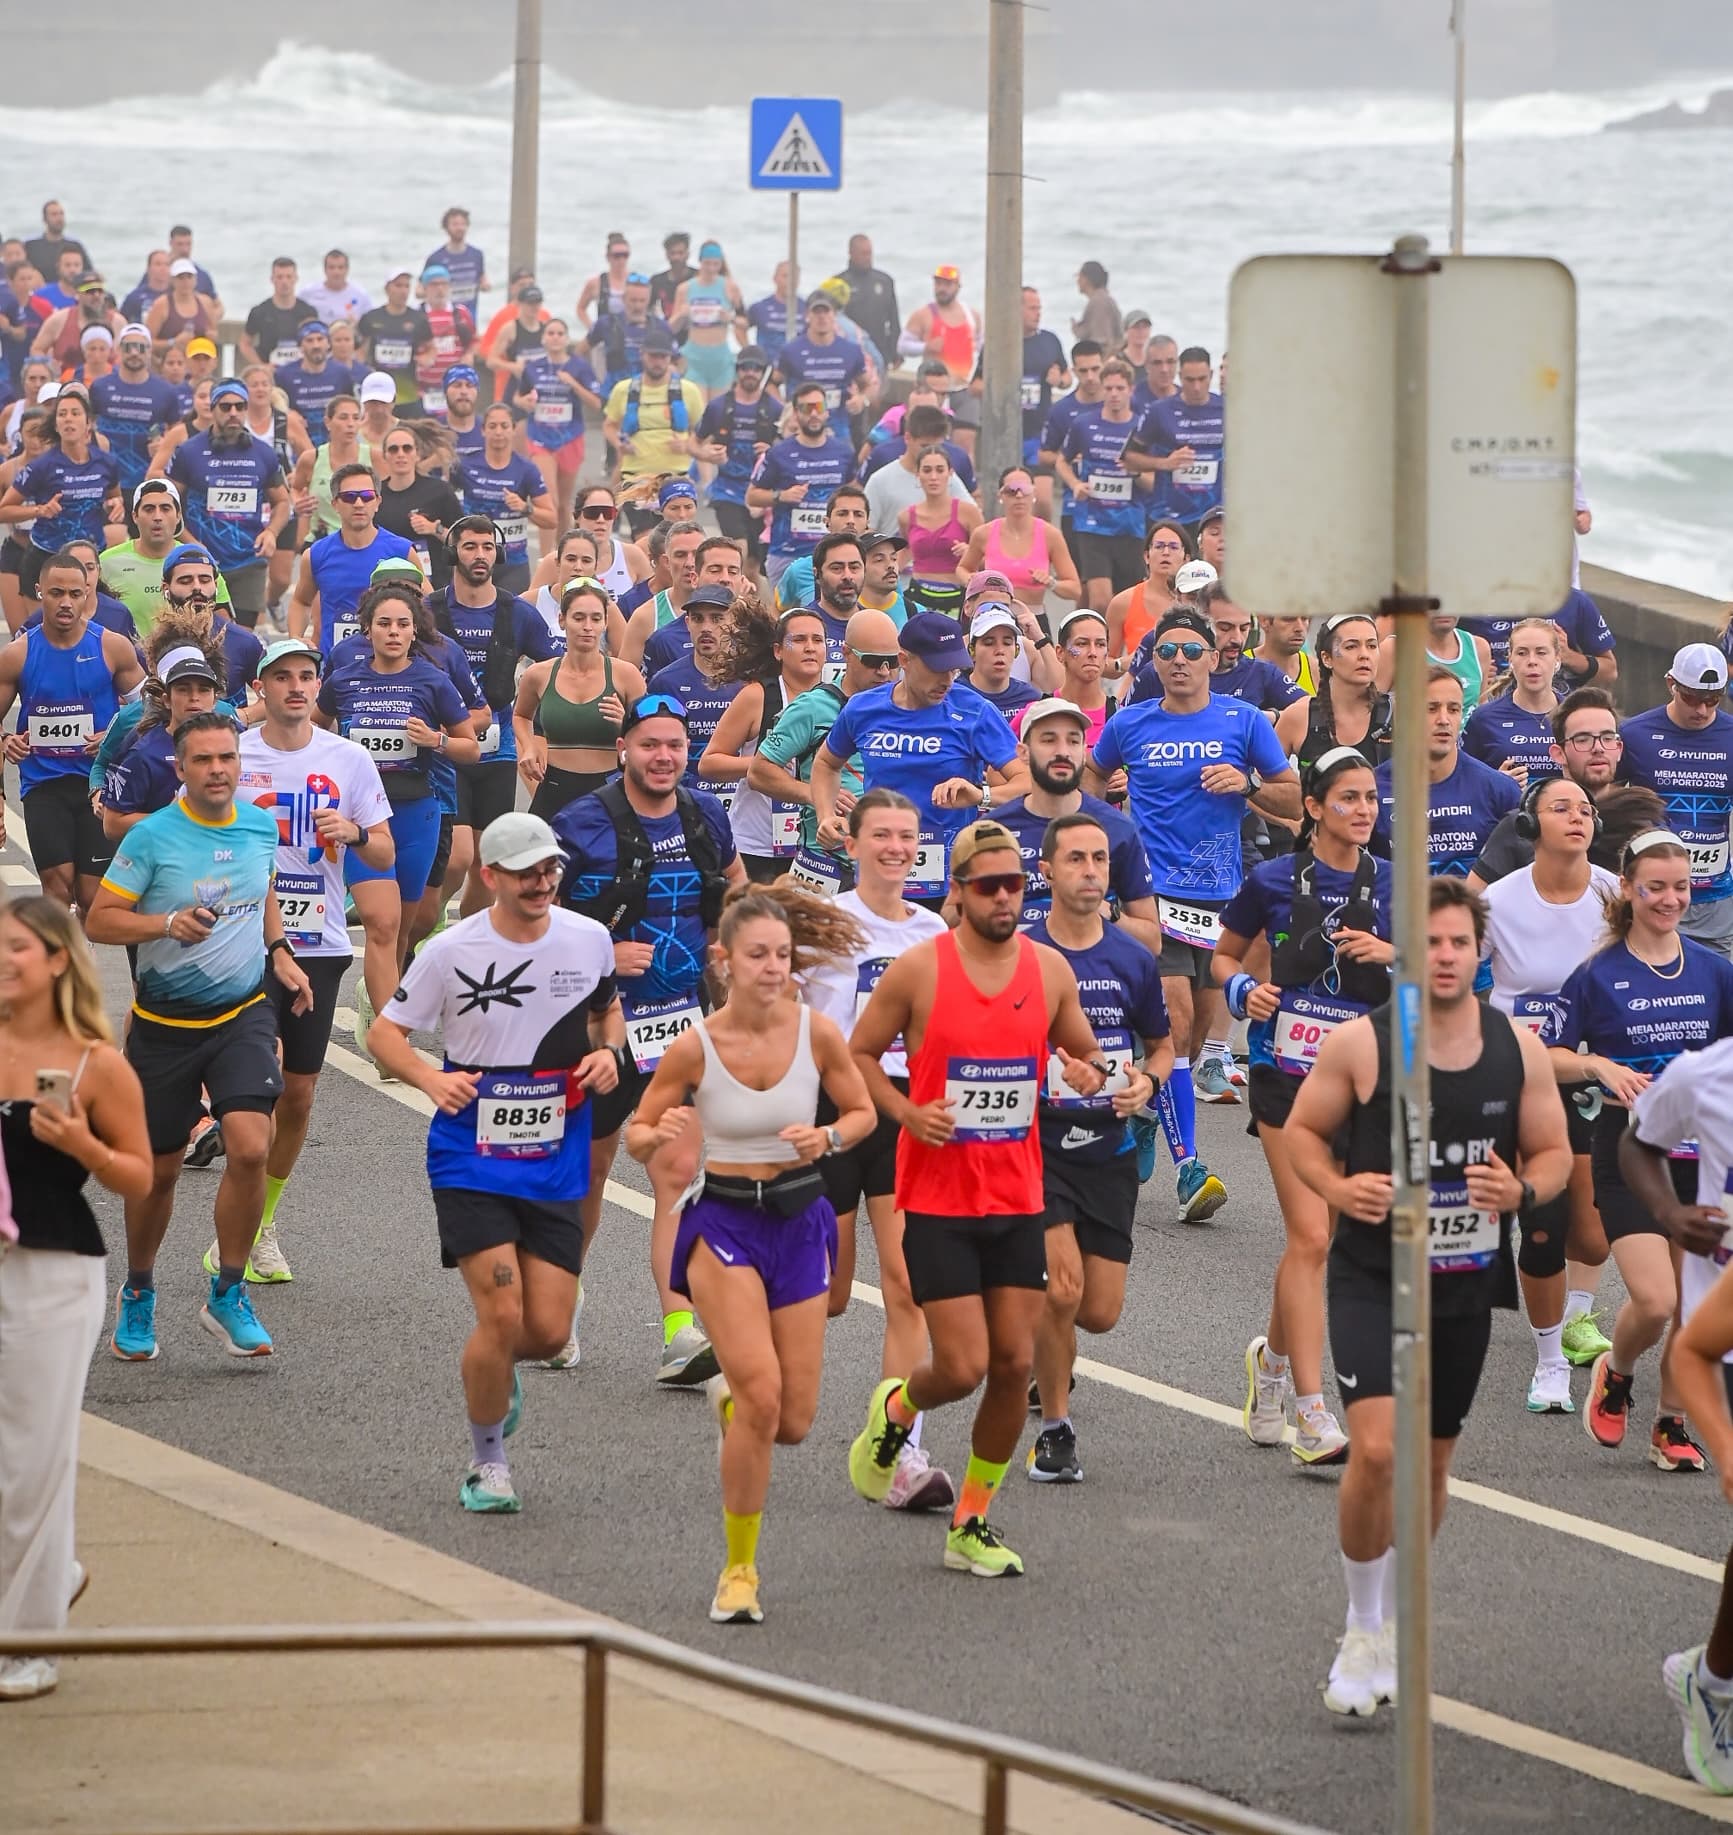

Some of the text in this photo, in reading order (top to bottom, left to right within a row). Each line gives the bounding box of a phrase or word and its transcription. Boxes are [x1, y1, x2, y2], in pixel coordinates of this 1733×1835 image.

[217, 492, 247, 503] 7783
[798, 513, 827, 523] 468
[49, 704, 84, 713] HYUNDAI
[38, 723, 81, 738] 8401
[360, 737, 404, 751] 8369
[864, 732, 942, 754] zome
[1141, 739, 1223, 760] zome
[1679, 751, 1727, 760] HYUNDAI
[1654, 770, 1728, 781] MEIA MARATONA
[1672, 778, 1703, 787] PORTO
[1703, 779, 1725, 788] 2025
[652, 833, 686, 852] HYUN
[1448, 841, 1474, 852] 2025
[214, 849, 233, 861] DK
[1686, 848, 1720, 863] 145
[802, 856, 835, 873] HYUNDAI
[278, 879, 318, 889] HYUNDAI
[1168, 906, 1213, 928] 2538
[1652, 994, 1706, 1009] HYUNDAI
[1312, 1003, 1359, 1019] HYUNDAI
[633, 1016, 692, 1044] 12540
[1626, 1020, 1710, 1036] MEIA MARATONA
[1650, 1032, 1684, 1043] PORTO
[1685, 1029, 1707, 1040] 2025
[982, 1064, 1028, 1077] HYUNDAI
[513, 1082, 558, 1096] HYUNDAI
[961, 1089, 1020, 1109] 7336
[492, 1105, 553, 1127] 8836
[980, 1115, 1005, 1124] PEDRO
[508, 1130, 541, 1139] TIMOTHE
[1433, 1241, 1471, 1251] ROBERTO
